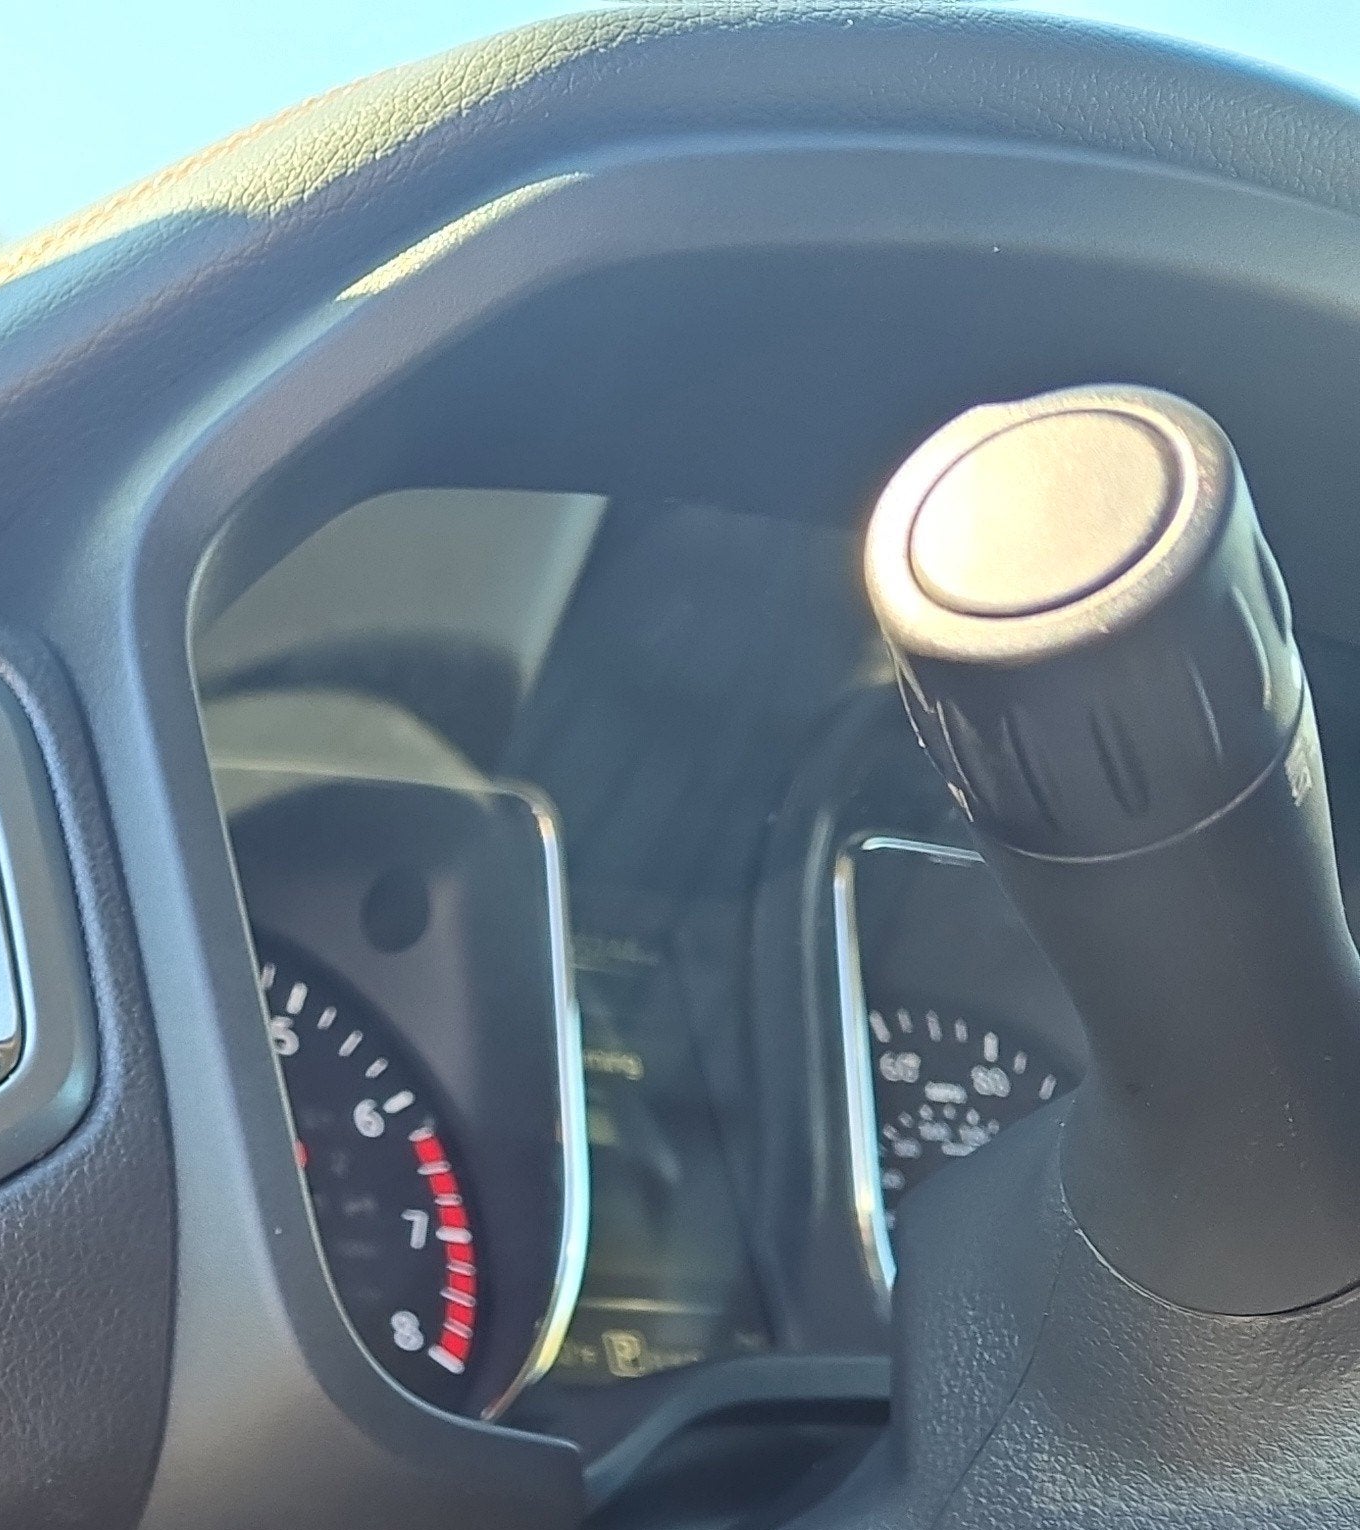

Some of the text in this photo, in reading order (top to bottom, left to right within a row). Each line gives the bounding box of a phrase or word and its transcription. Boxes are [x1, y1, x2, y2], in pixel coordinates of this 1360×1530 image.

[353, 1099, 385, 1138] 6
[401, 1209, 430, 1250] 7
[390, 1310, 424, 1351] 8
